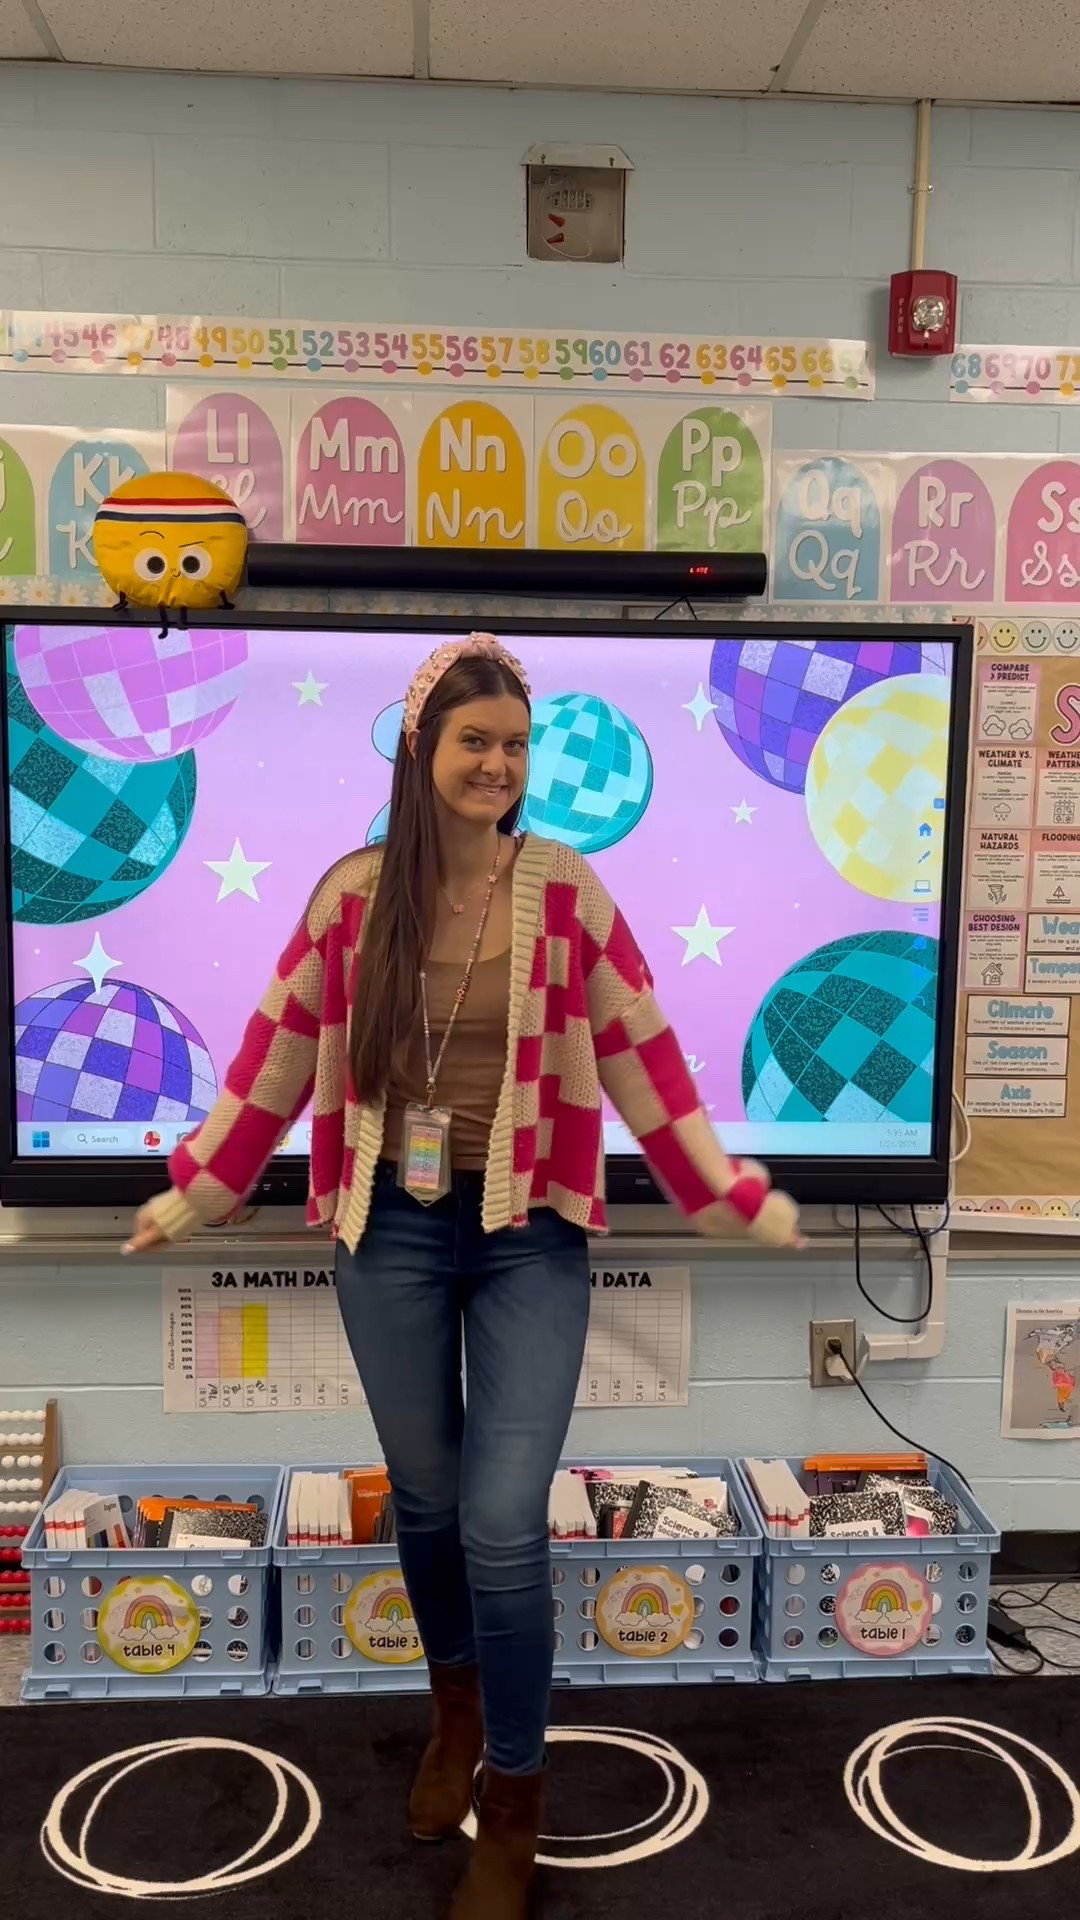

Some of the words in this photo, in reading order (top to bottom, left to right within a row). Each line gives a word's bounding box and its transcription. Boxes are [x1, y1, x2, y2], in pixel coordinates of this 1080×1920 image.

[44, 321, 79, 347] 45
[83, 323, 117, 348] 46
[157, 325, 190, 350] 48
[195, 325, 227, 352] 49
[232, 327, 264, 354] 50
[269, 328, 298, 355] 51
[302, 329, 334, 356] 52
[338, 330, 369, 358] 53
[374, 333, 408, 360] 54
[411, 333, 445, 360] 55
[446, 335, 478, 362] 56
[480, 336, 514, 363] 57
[519, 337, 549, 364] 58
[555, 339, 587, 365] 59
[589, 340, 621, 366] 60
[623, 340, 652, 367] 61
[659, 343, 690, 369] 62
[696, 343, 727, 370] 63
[730, 345, 762, 371] 64
[765, 346, 796, 372] 65
[802, 347, 833, 373] 66
[951, 353, 982, 379] 68
[985, 353, 1017, 378] 69
[1019, 354, 1051, 380] 70
[310, 417, 398, 473] Mm
[440, 417, 506, 472] Nn
[549, 419, 637, 478] Oo
[682, 418, 743, 487] Pp
[298, 484, 403, 526] Mm
[800, 469, 863, 538] Qq
[918, 476, 975, 528] Rr
[426, 488, 523, 543] Nn
[557, 489, 632, 543] Oo
[673, 480, 752, 547] Pp
[789, 530, 863, 599] Qq
[904, 539, 985, 590] Rr
[1022, 541, 1080, 588] Ss
[991, 663, 1030, 672] COMPARE
[997, 673, 1029, 681] PREDICT
[978, 750, 1016, 758] WEATHER
[1019, 750, 1032, 759] VS.
[988, 759, 1022, 768] CLIMATE
[981, 833, 1019, 841] NATURAL
[980, 842, 1019, 850] HAZARDS
[973, 914, 1016, 922] CHOOSING
[968, 923, 988, 931] BEST
[990, 923, 1020, 931] DESIGN
[988, 999, 1054, 1019] Climate
[987, 1040, 1048, 1059] Season
[1000, 1083, 1031, 1099] Axis
[91, 1134, 119, 1144] Search
[211, 1271, 237, 1288] 3A
[243, 1271, 297, 1288] MATH
[303, 1270, 337, 1287] DAT
[603, 1272, 652, 1287] DATA
[200, 1397, 207, 1407] CA
[223, 1397, 230, 1407] CA
[247, 1397, 254, 1407] CA
[270, 1396, 278, 1406] CA
[294, 1396, 301, 1406] CA
[318, 1396, 325, 1405] CA
[341, 1395, 348, 1404] CA
[590, 1392, 597, 1401] CA
[613, 1392, 620, 1401] CA
[636, 1392, 643, 1401] CA
[658, 1392, 666, 1401] CA
[662, 1516, 700, 1538] Science
[618, 1629, 656, 1643] table
[660, 1632, 668, 1643] 2
[860, 1627, 899, 1640] table
[902, 1628, 906, 1640] 1
[369, 1635, 407, 1648] table
[411, 1636, 419, 1648] 3
[123, 1643, 163, 1657] table
[167, 1643, 176, 1657] 4
